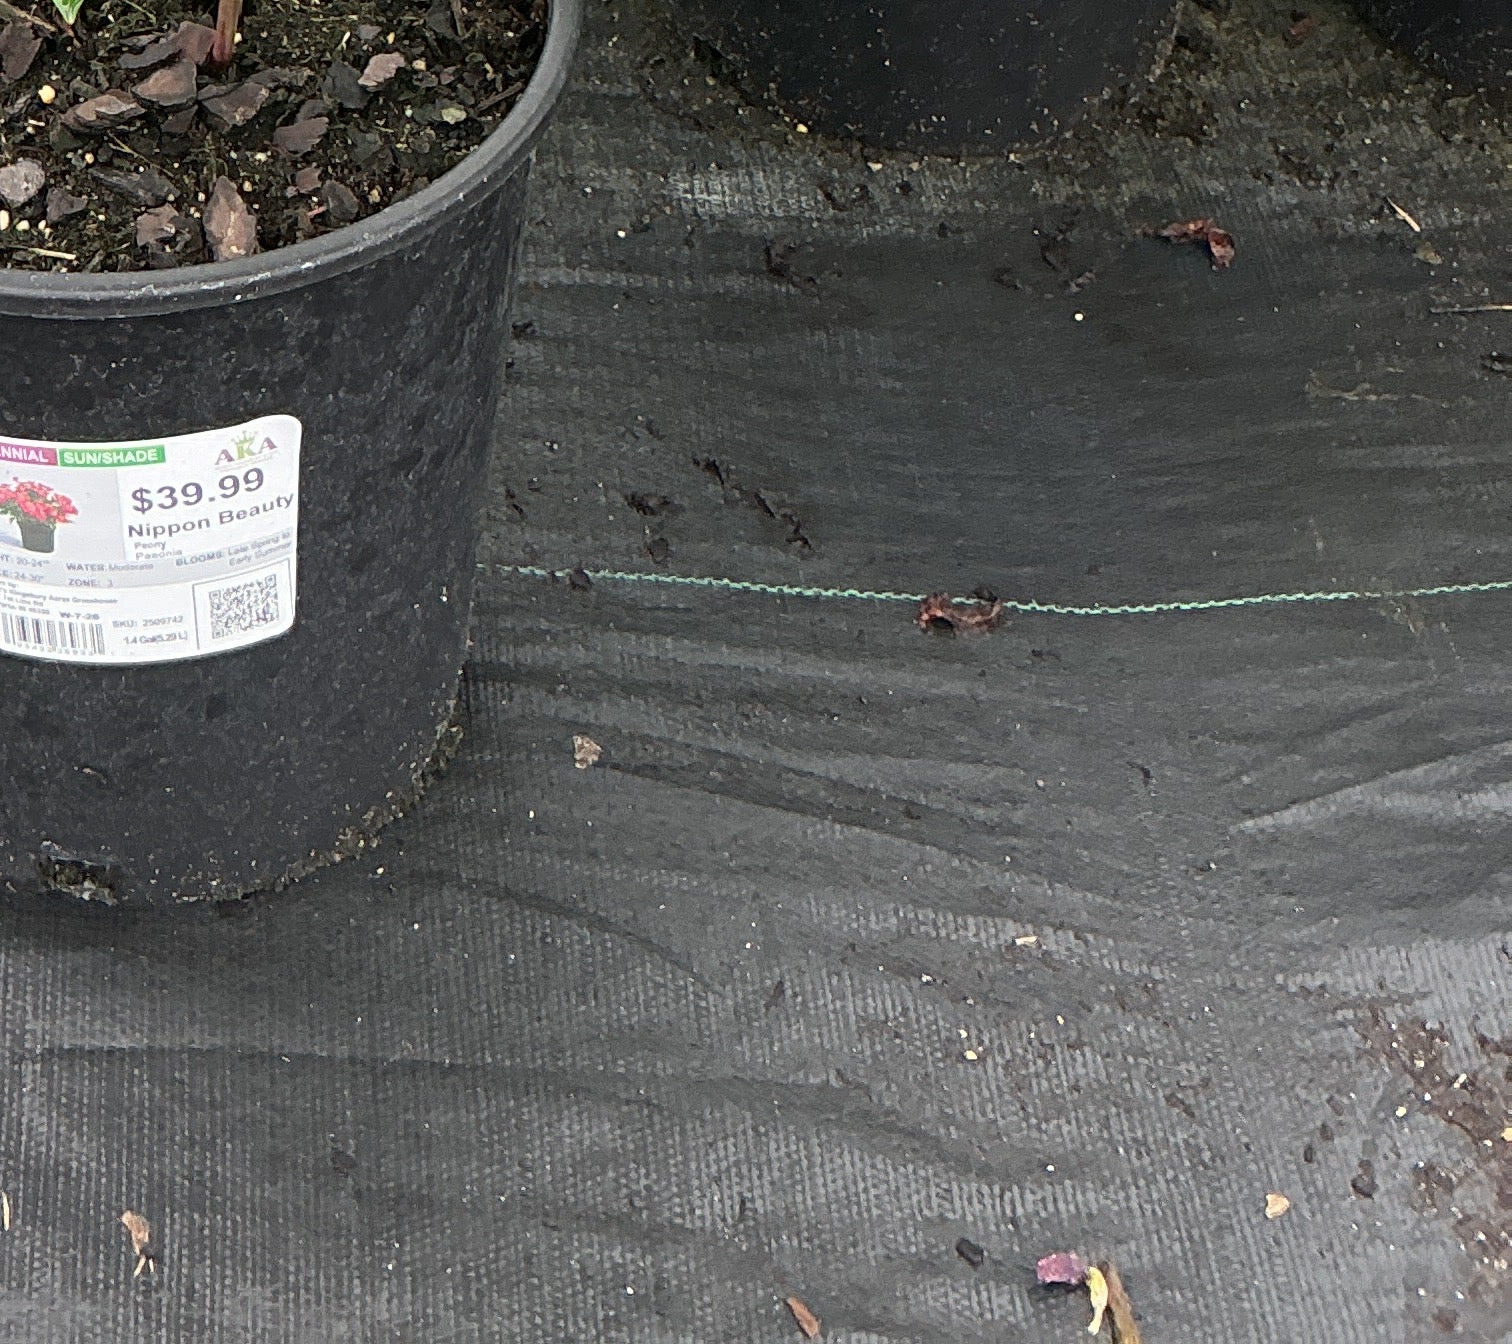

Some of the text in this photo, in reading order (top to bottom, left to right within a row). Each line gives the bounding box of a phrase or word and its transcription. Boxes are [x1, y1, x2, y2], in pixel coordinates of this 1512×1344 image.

[64, 448, 158, 464] SUN/SHADE
[215, 436, 278, 465] AKA
[132, 467, 264, 515] $39.99
[128, 493, 294, 539] Nippon Beauty
